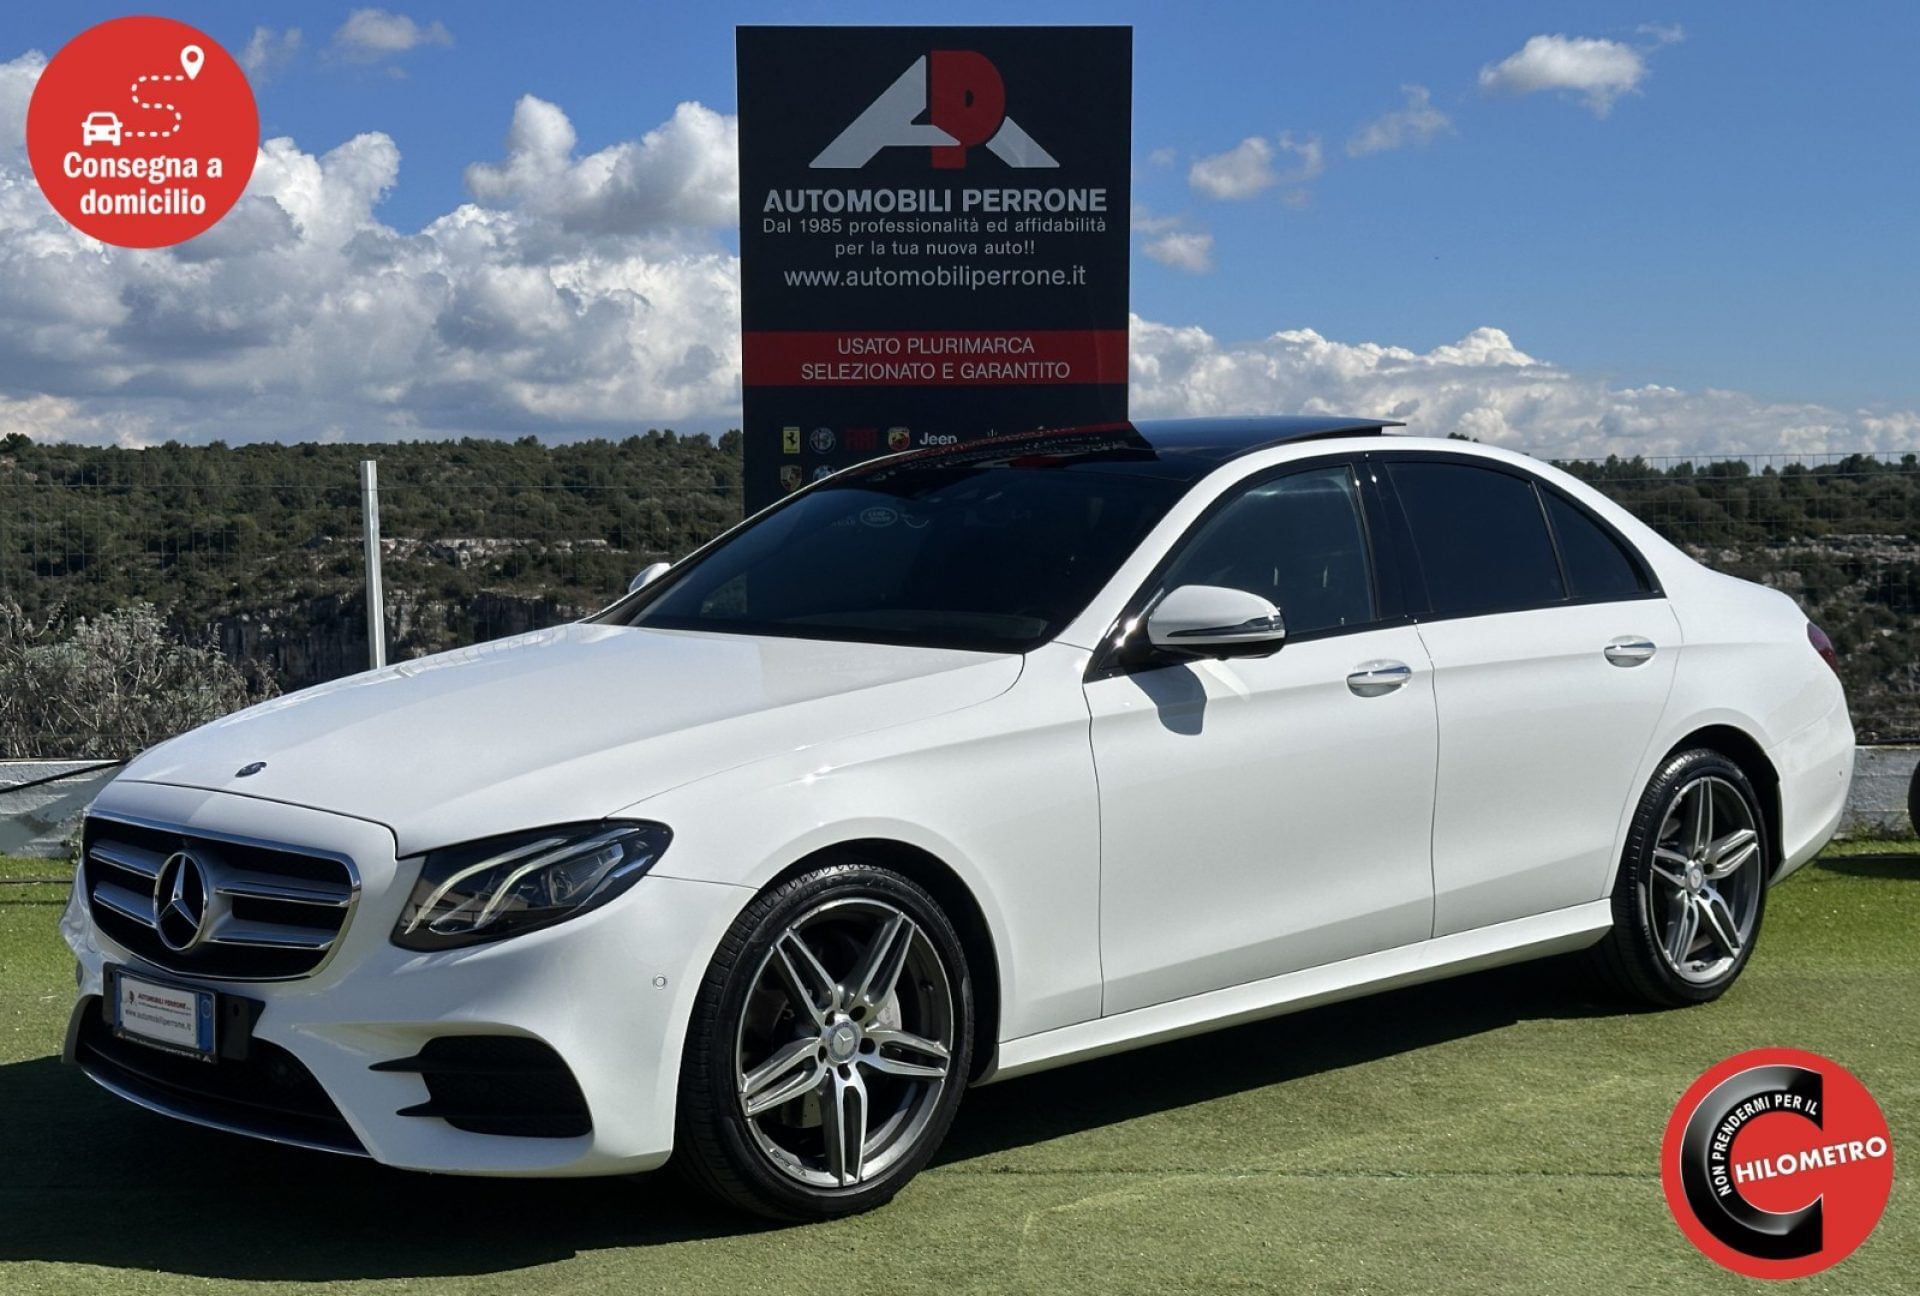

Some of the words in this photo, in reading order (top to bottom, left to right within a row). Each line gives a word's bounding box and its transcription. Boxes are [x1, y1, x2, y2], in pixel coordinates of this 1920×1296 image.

[763, 188, 952, 213] AUTOMOBILI
[962, 188, 1107, 212] PERRONE
[763, 218, 791, 234] Dal
[800, 218, 842, 233] 1985
[849, 217, 979, 236] professionalità
[986, 217, 1008, 233] ed
[1015, 217, 1106, 233] affidabilità
[835, 242, 864, 258] per
[871, 240, 886, 255] la
[892, 241, 919, 256] tua
[926, 243, 978, 255] nuova
[984, 240, 1035, 255] auto!!
[784, 266, 1086, 290] www.automobiliperrone.it
[837, 337, 901, 354] USATO
[907, 336, 1035, 354] PLURIMARCA
[801, 362, 936, 380] SELEZIONATO
[943, 363, 954, 379] E
[960, 361, 1071, 380] GARANTITO
[919, 432, 957, 446] Jeep
